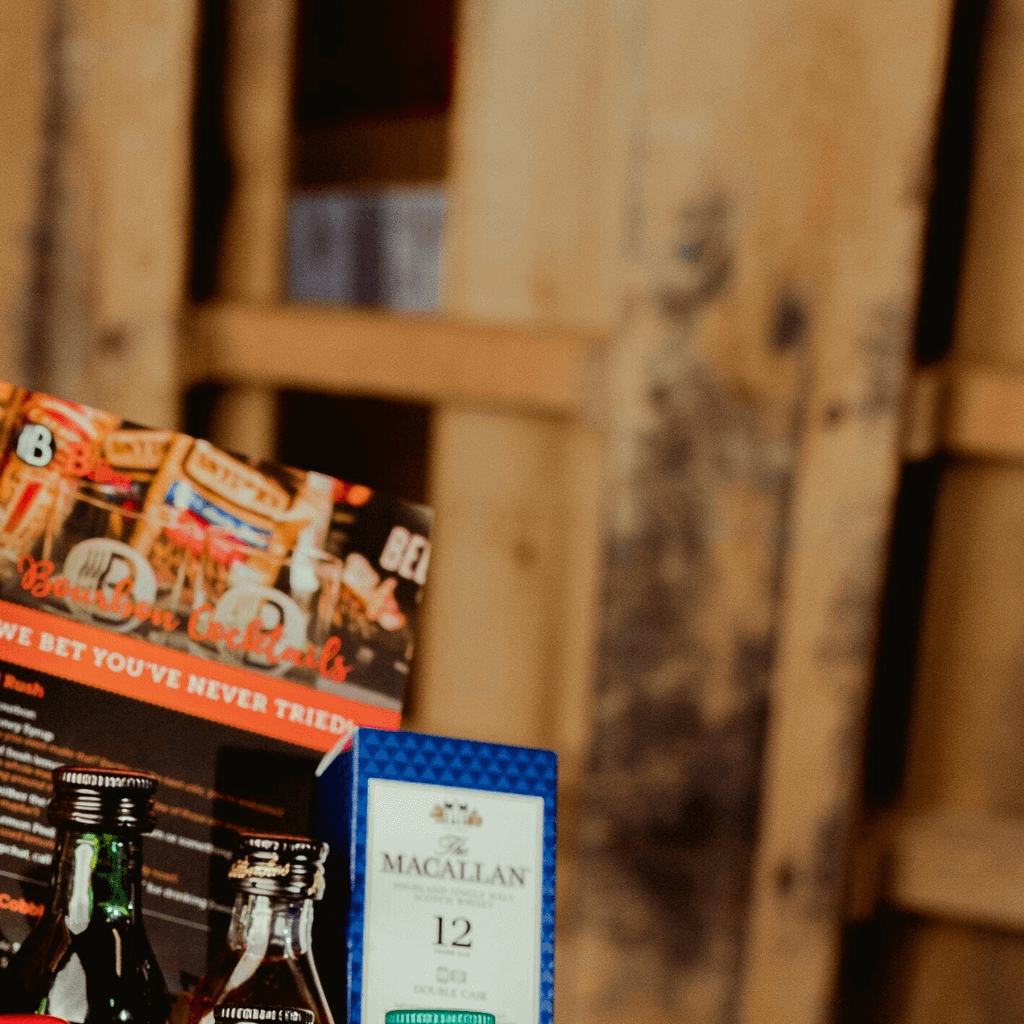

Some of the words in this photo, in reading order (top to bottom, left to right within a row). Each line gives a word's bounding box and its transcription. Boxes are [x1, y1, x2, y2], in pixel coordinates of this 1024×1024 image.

[17, 553, 180, 632] Bourbon
[188, 604, 353, 683] Cocktails
[39, 631, 87, 661] BET
[92, 647, 182, 689] YOU'VE
[187, 674, 268, 714] NEVER
[380, 853, 527, 887] MACALLAN
[432, 914, 473, 949] 12
